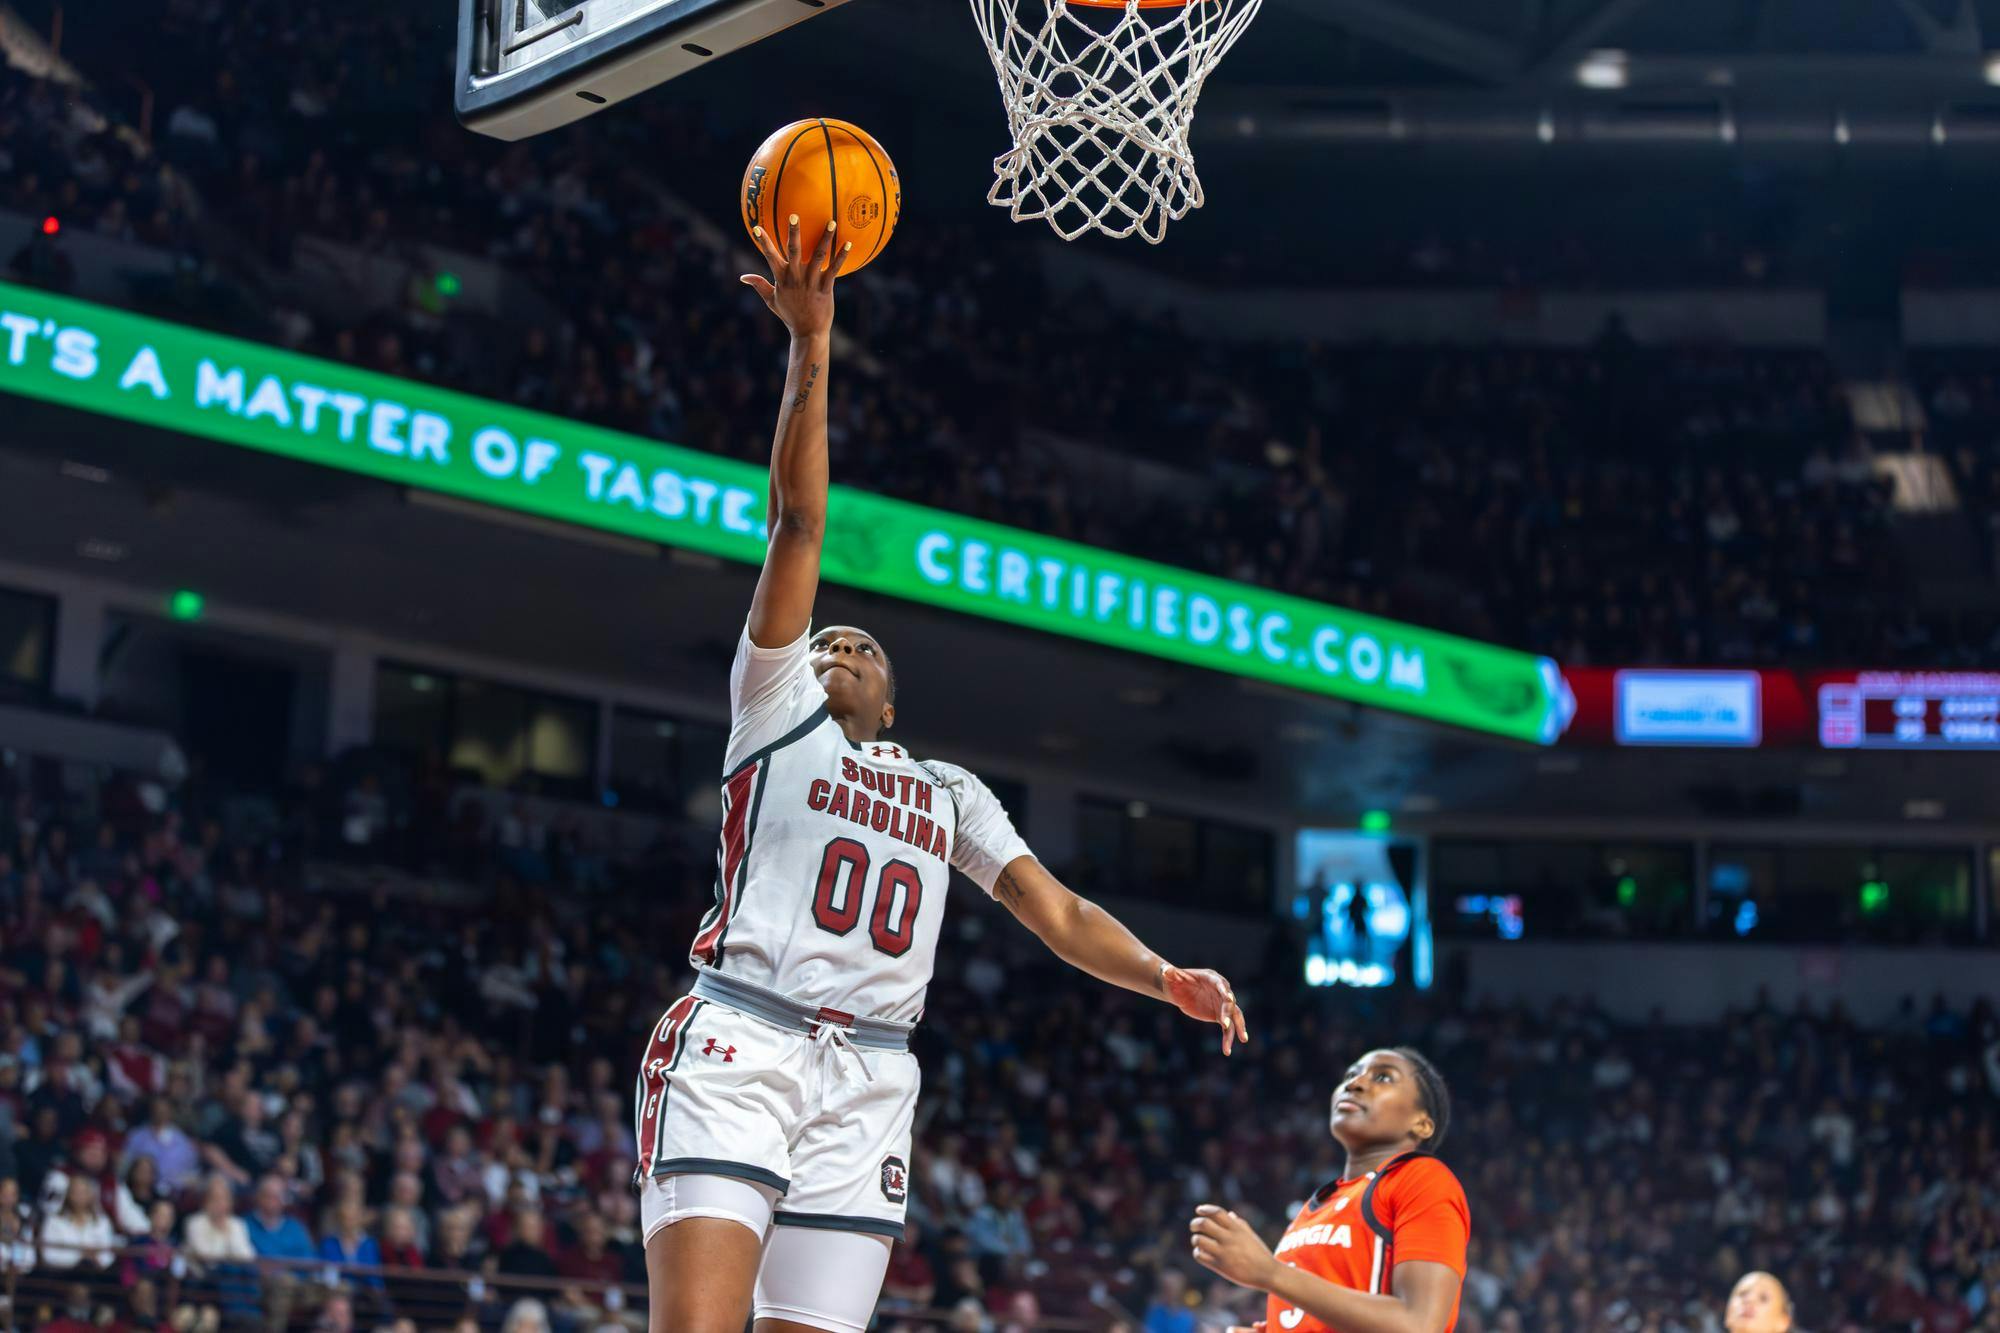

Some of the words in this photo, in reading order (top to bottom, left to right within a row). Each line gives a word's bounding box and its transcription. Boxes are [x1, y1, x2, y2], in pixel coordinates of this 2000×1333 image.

[119, 345, 170, 399] A
[195, 358, 452, 464] MATTER
[471, 426, 561, 484] OF
[916, 531, 1426, 694] CERTIFIEDSC.COM
[807, 778, 947, 862] CAROLINA
[841, 756, 932, 813] SOUTH
[811, 836, 923, 959] 00
